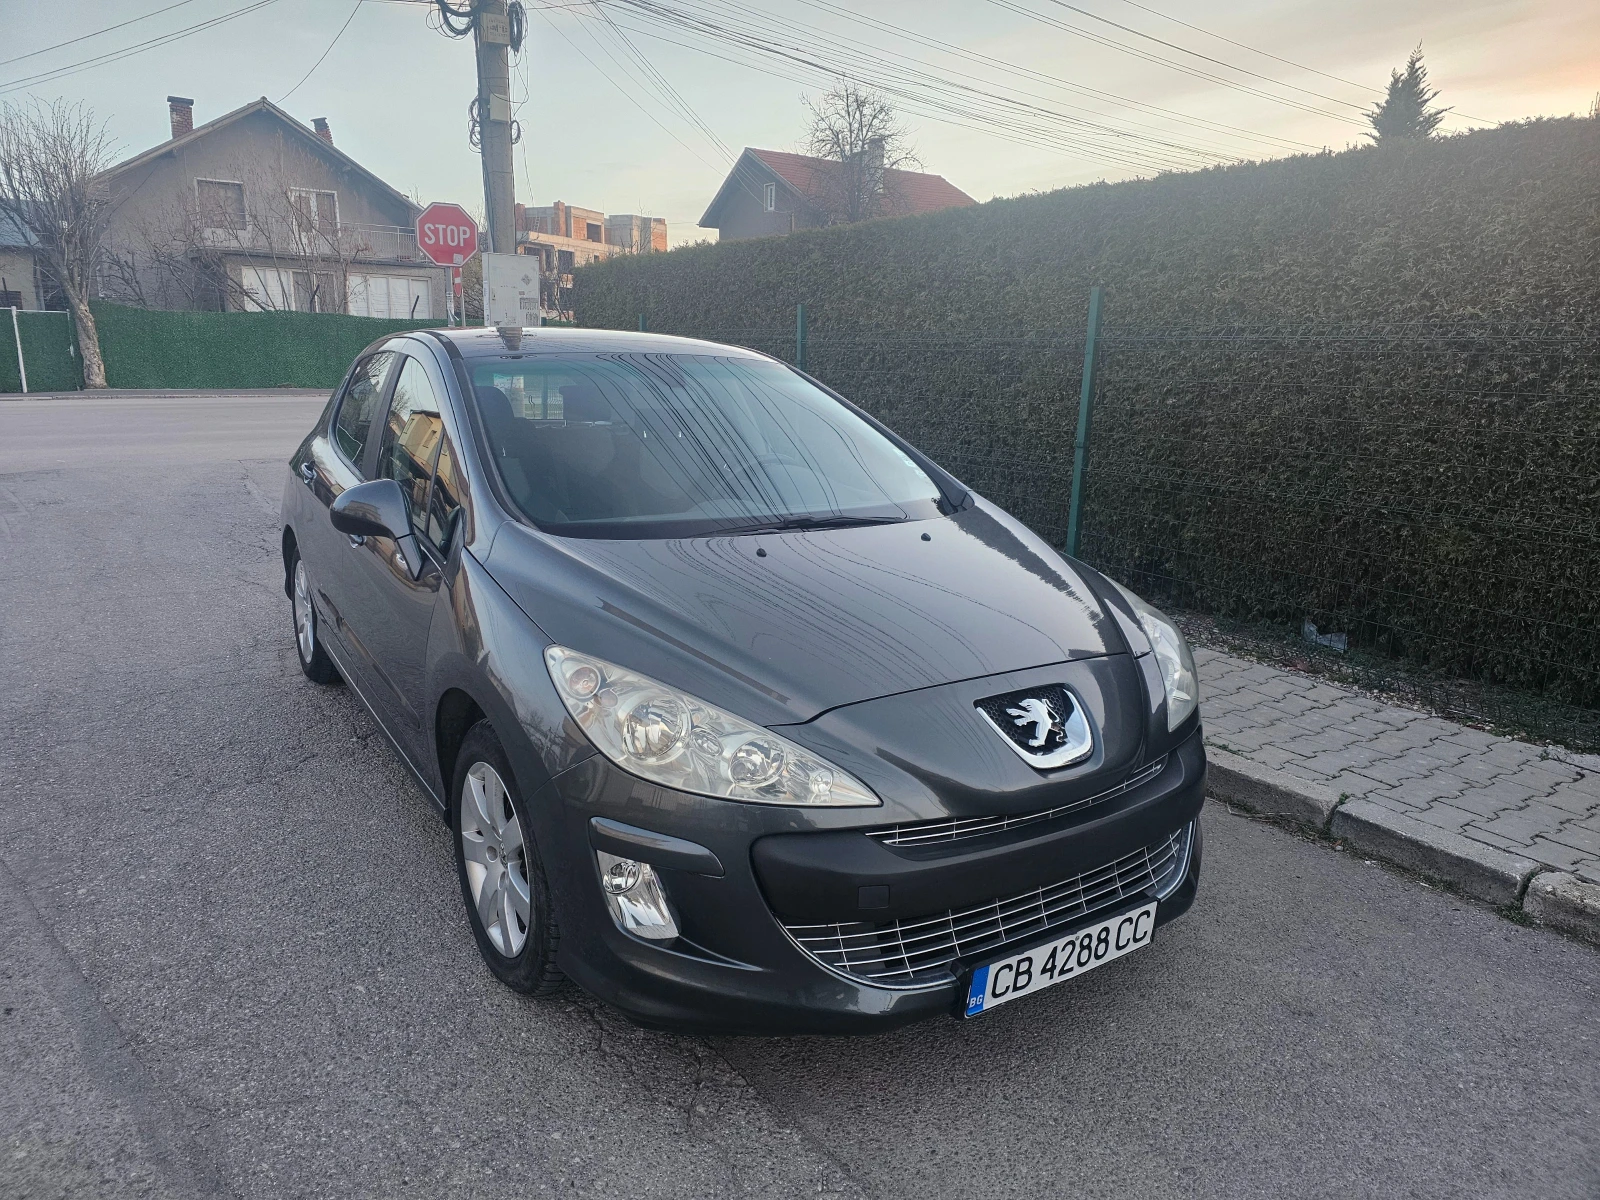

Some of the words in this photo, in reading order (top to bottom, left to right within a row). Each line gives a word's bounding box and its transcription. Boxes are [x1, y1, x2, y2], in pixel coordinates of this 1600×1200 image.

[425, 224, 470, 246] STOP
[992, 957, 1033, 999] CB
[1040, 927, 1110, 980] 4288
[1116, 910, 1150, 950] CC
[969, 995, 983, 1007] BG
